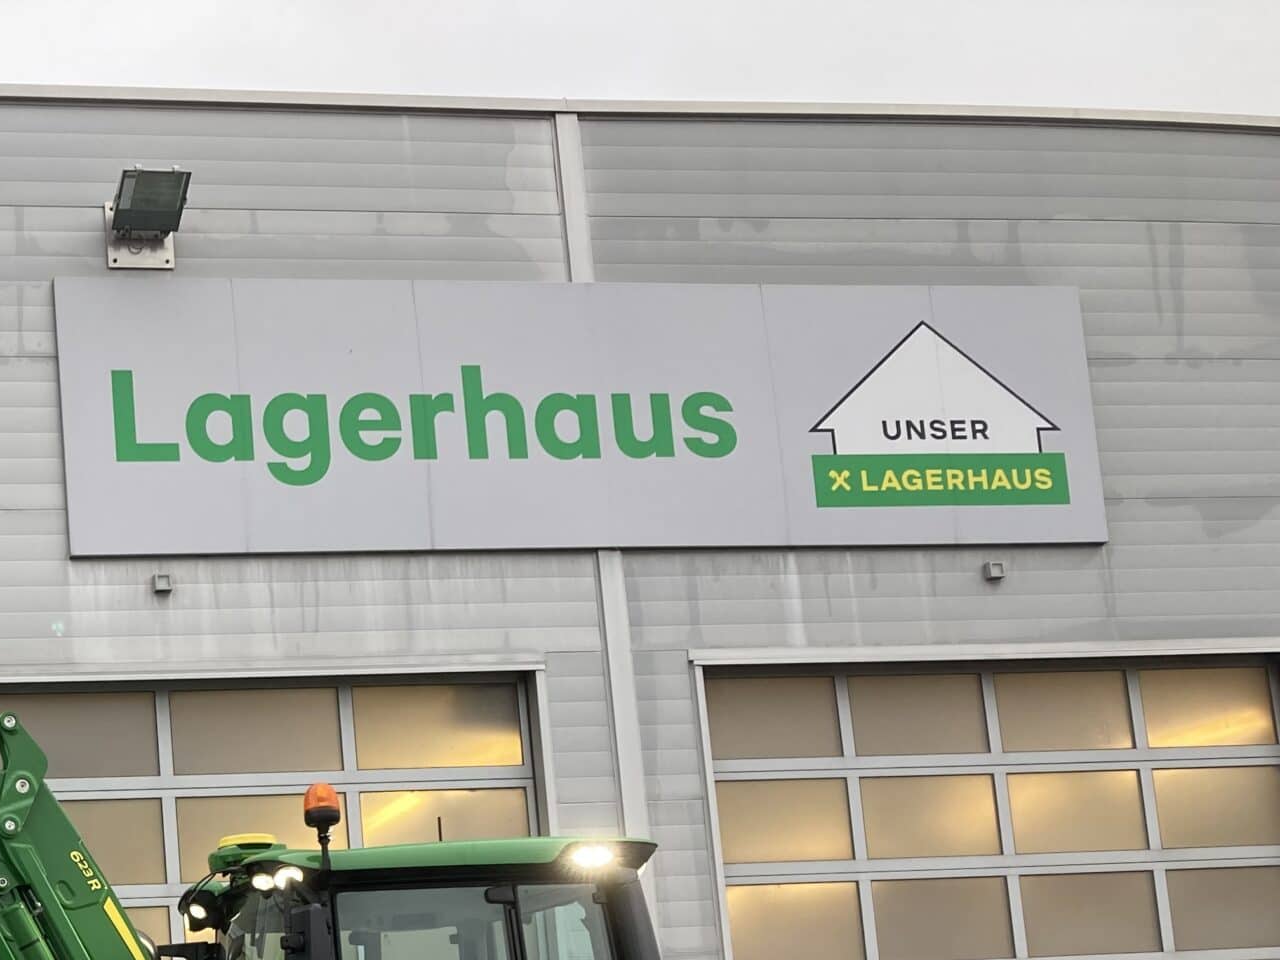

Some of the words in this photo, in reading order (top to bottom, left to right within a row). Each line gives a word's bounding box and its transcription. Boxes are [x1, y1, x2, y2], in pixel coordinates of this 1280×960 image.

[110, 364, 739, 487] Lagerhaus
[881, 419, 990, 441] UNSER
[860, 468, 1053, 492] LAGERHAUS
